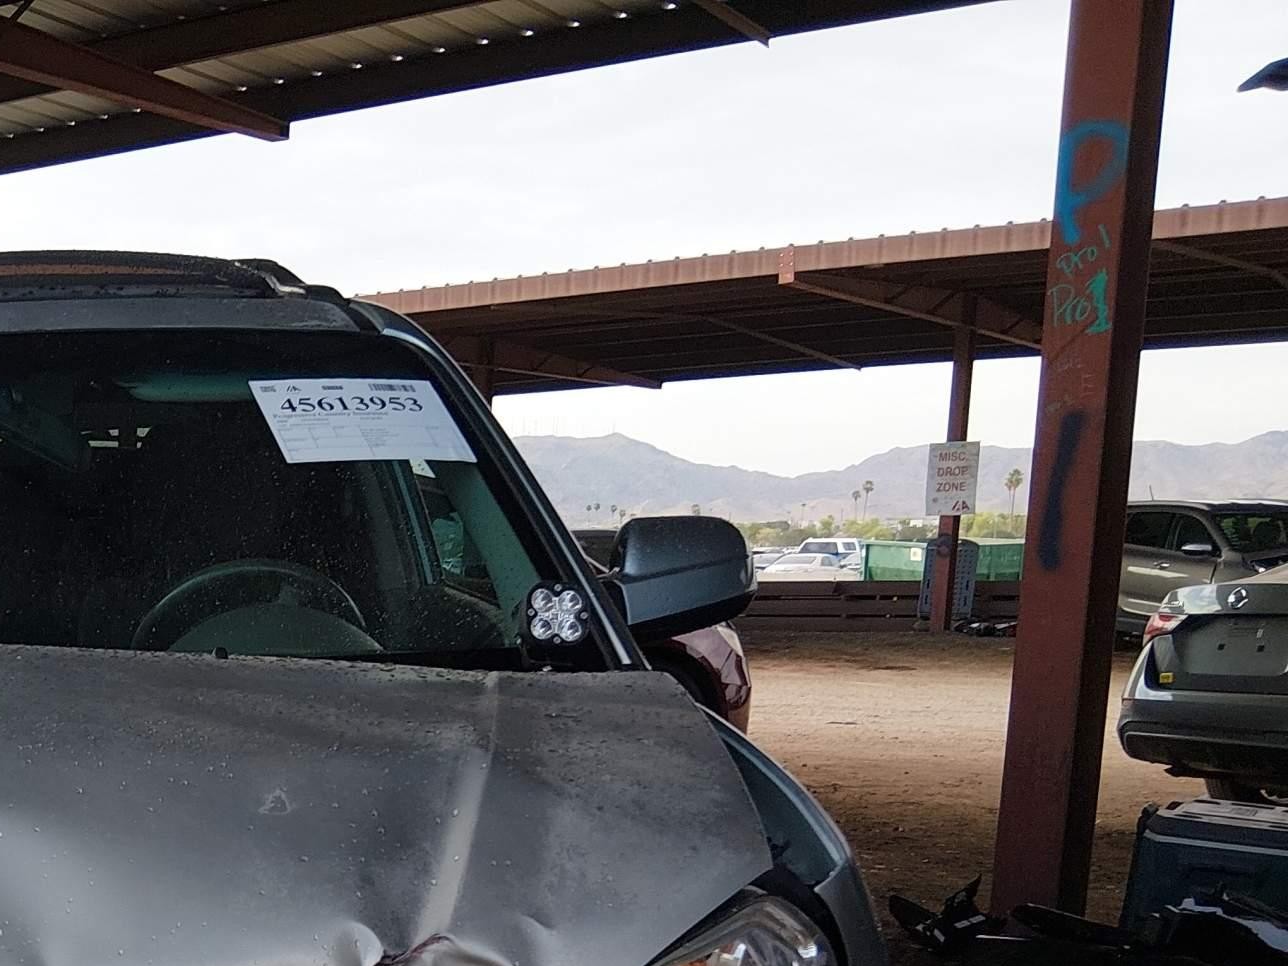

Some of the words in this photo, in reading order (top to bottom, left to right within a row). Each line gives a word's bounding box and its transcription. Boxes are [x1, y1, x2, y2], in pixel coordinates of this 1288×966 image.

[280, 396, 424, 413] 45613953
[936, 466, 969, 477] DROP
[936, 481, 967, 493] ZONE
